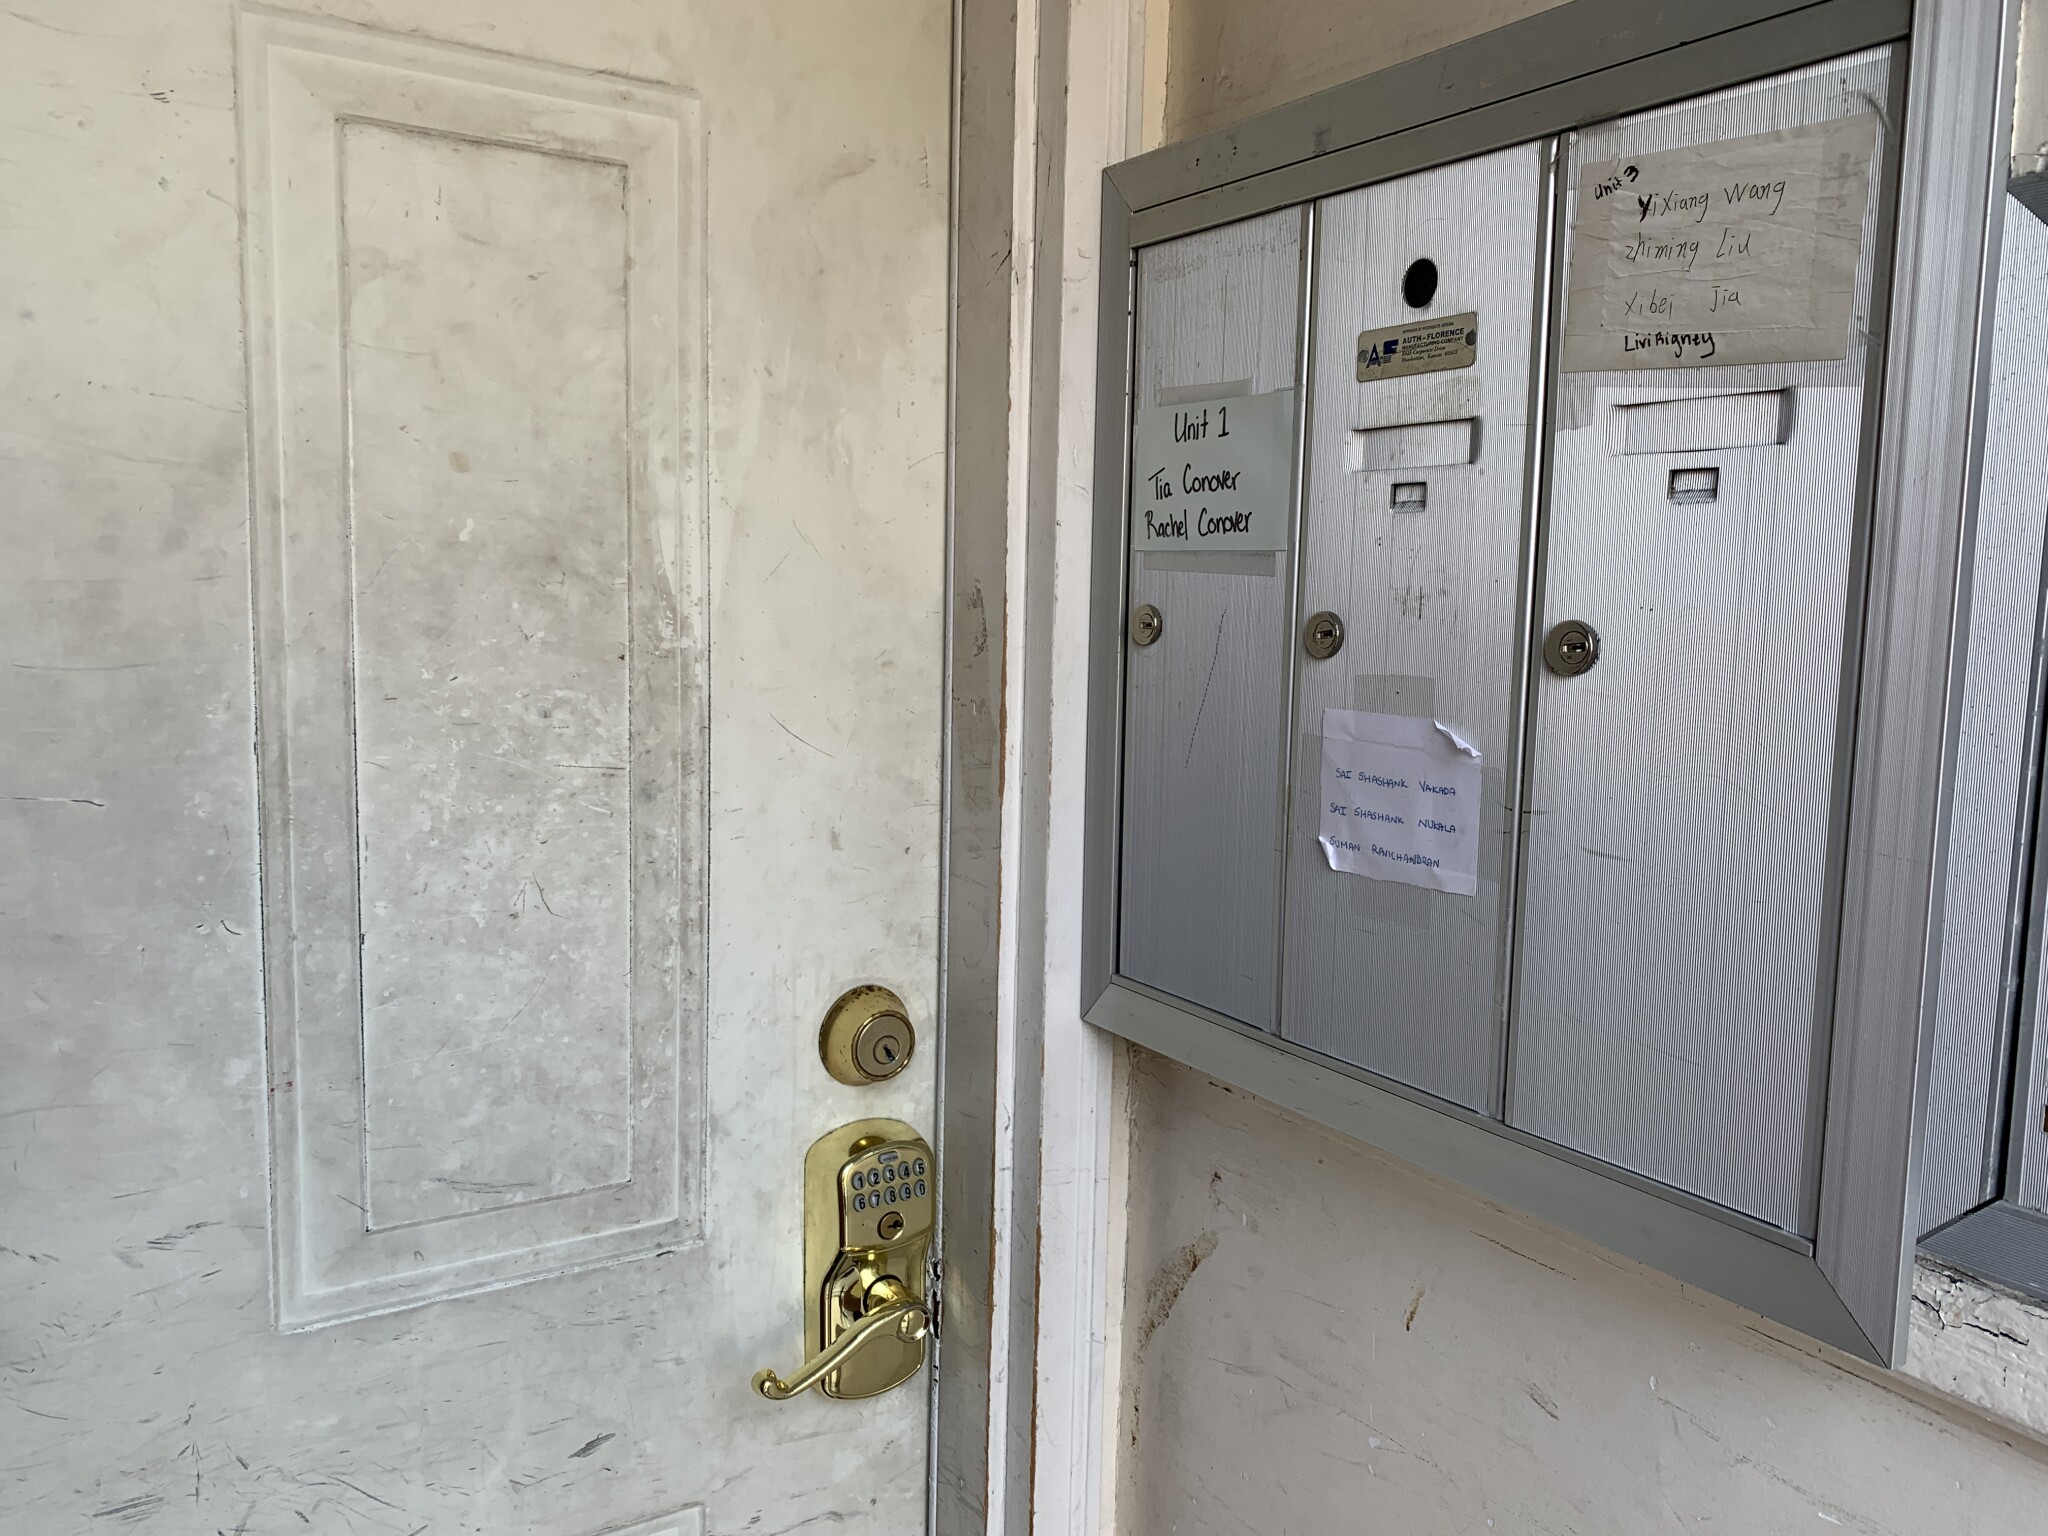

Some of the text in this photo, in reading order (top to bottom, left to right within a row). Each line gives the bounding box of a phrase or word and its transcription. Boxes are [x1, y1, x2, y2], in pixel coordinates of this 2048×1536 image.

[1594, 165, 1639, 200] Unit 3
[1724, 180, 1786, 216] Wang
[1440, 336, 1465, 344] COMPANY
[1174, 406, 1229, 443] Unit 1
[1148, 463, 1241, 500] Tia Conover
[1145, 507, 1252, 541] Rachel Conover
[1335, 767, 1456, 796] SAI SHASHANK VAKADA
[1329, 803, 1456, 834] SAI SHASHANK NUKALA
[1329, 835, 1361, 852] SUMAN
